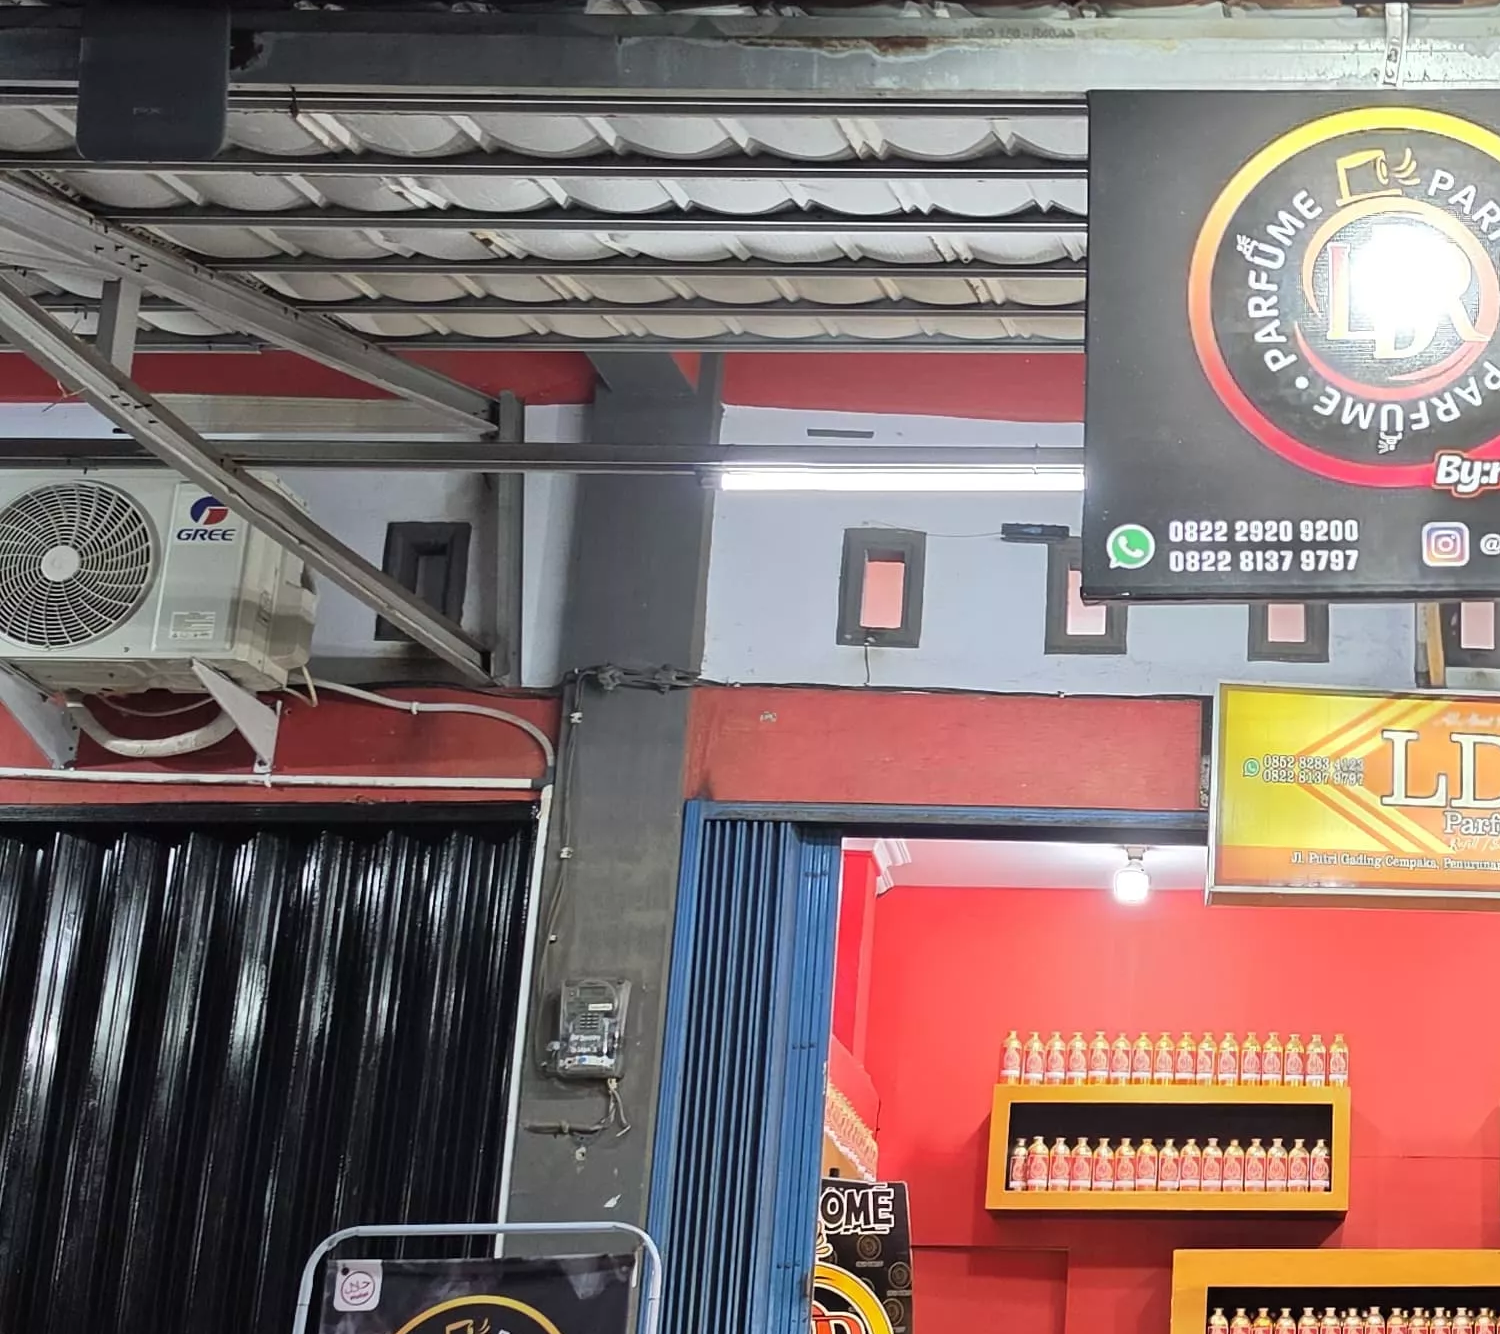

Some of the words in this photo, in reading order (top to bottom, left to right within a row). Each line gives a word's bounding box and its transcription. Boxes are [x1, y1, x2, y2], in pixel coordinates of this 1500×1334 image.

[176, 528, 236, 542] GREE
[1169, 520, 1227, 543] 0822
[1234, 520, 1293, 543] 2920
[1299, 520, 1359, 542] 9200
[1169, 550, 1231, 572] 0822
[1239, 550, 1292, 572] 8137
[1299, 550, 1359, 572] 9797
[1262, 769, 1295, 784] 0822
[1308, 852, 1337, 866] Putri
[1341, 853, 1382, 870] Gading
